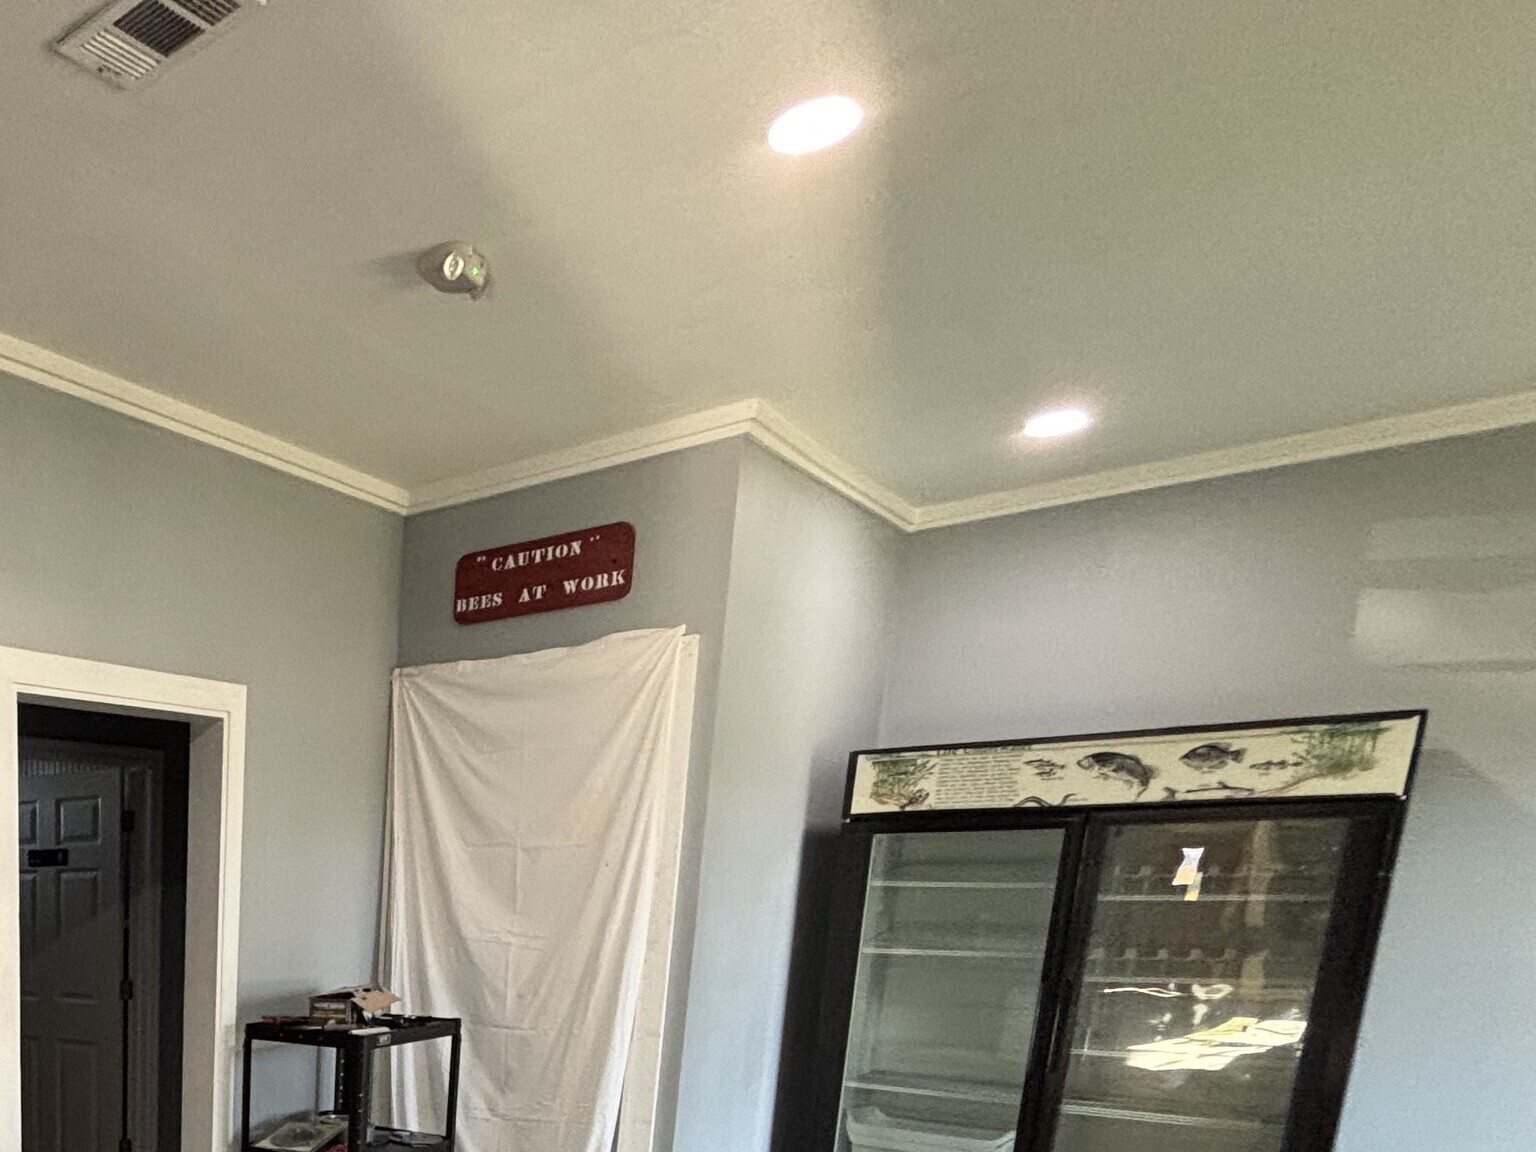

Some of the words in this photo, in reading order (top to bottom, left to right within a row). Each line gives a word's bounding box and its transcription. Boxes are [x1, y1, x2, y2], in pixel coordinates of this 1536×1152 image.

[456, 592, 503, 613] BEES
[518, 585, 547, 603] AT
[563, 569, 626, 595] WORK
